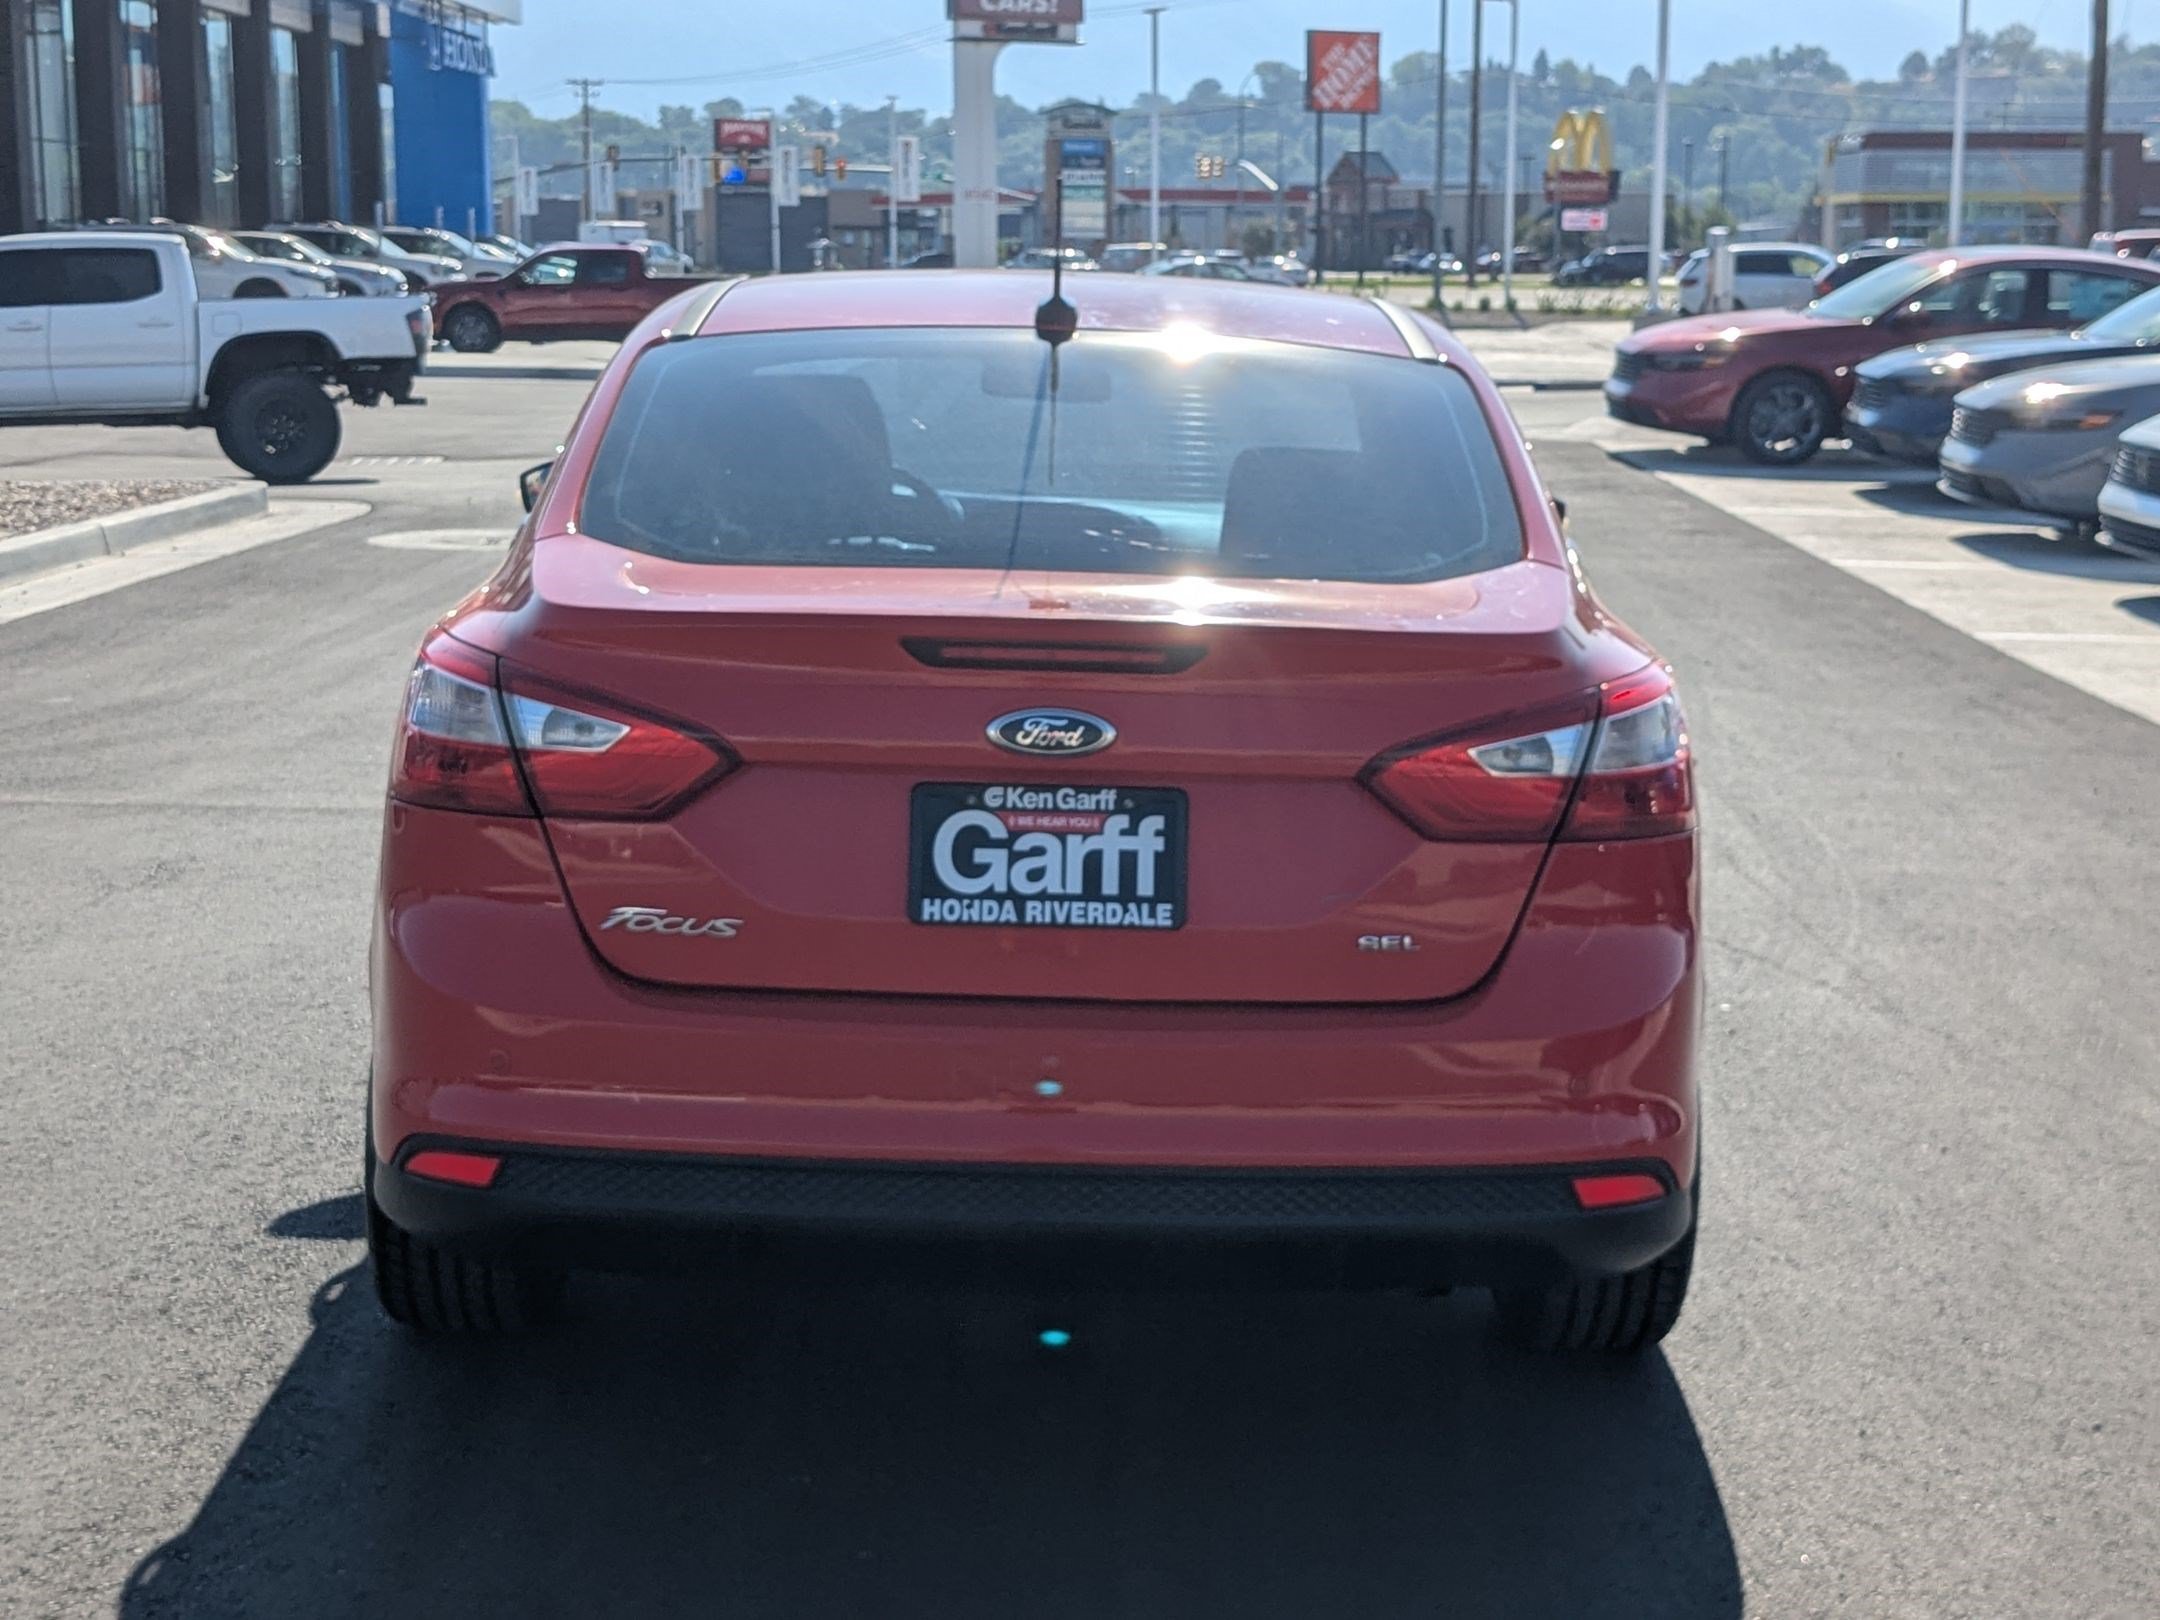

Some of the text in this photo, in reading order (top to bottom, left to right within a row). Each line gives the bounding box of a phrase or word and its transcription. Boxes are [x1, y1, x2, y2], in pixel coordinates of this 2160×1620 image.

[1015, 717, 1086, 747] Ford
[1005, 786, 1118, 811] Ken Garff
[1017, 815, 1035, 826] WE
[1036, 815, 1068, 826] HEAR
[933, 808, 1166, 897] Garff
[922, 897, 1174, 927] HONDA RIVERDALE
[1357, 934, 1421, 951] SEL
